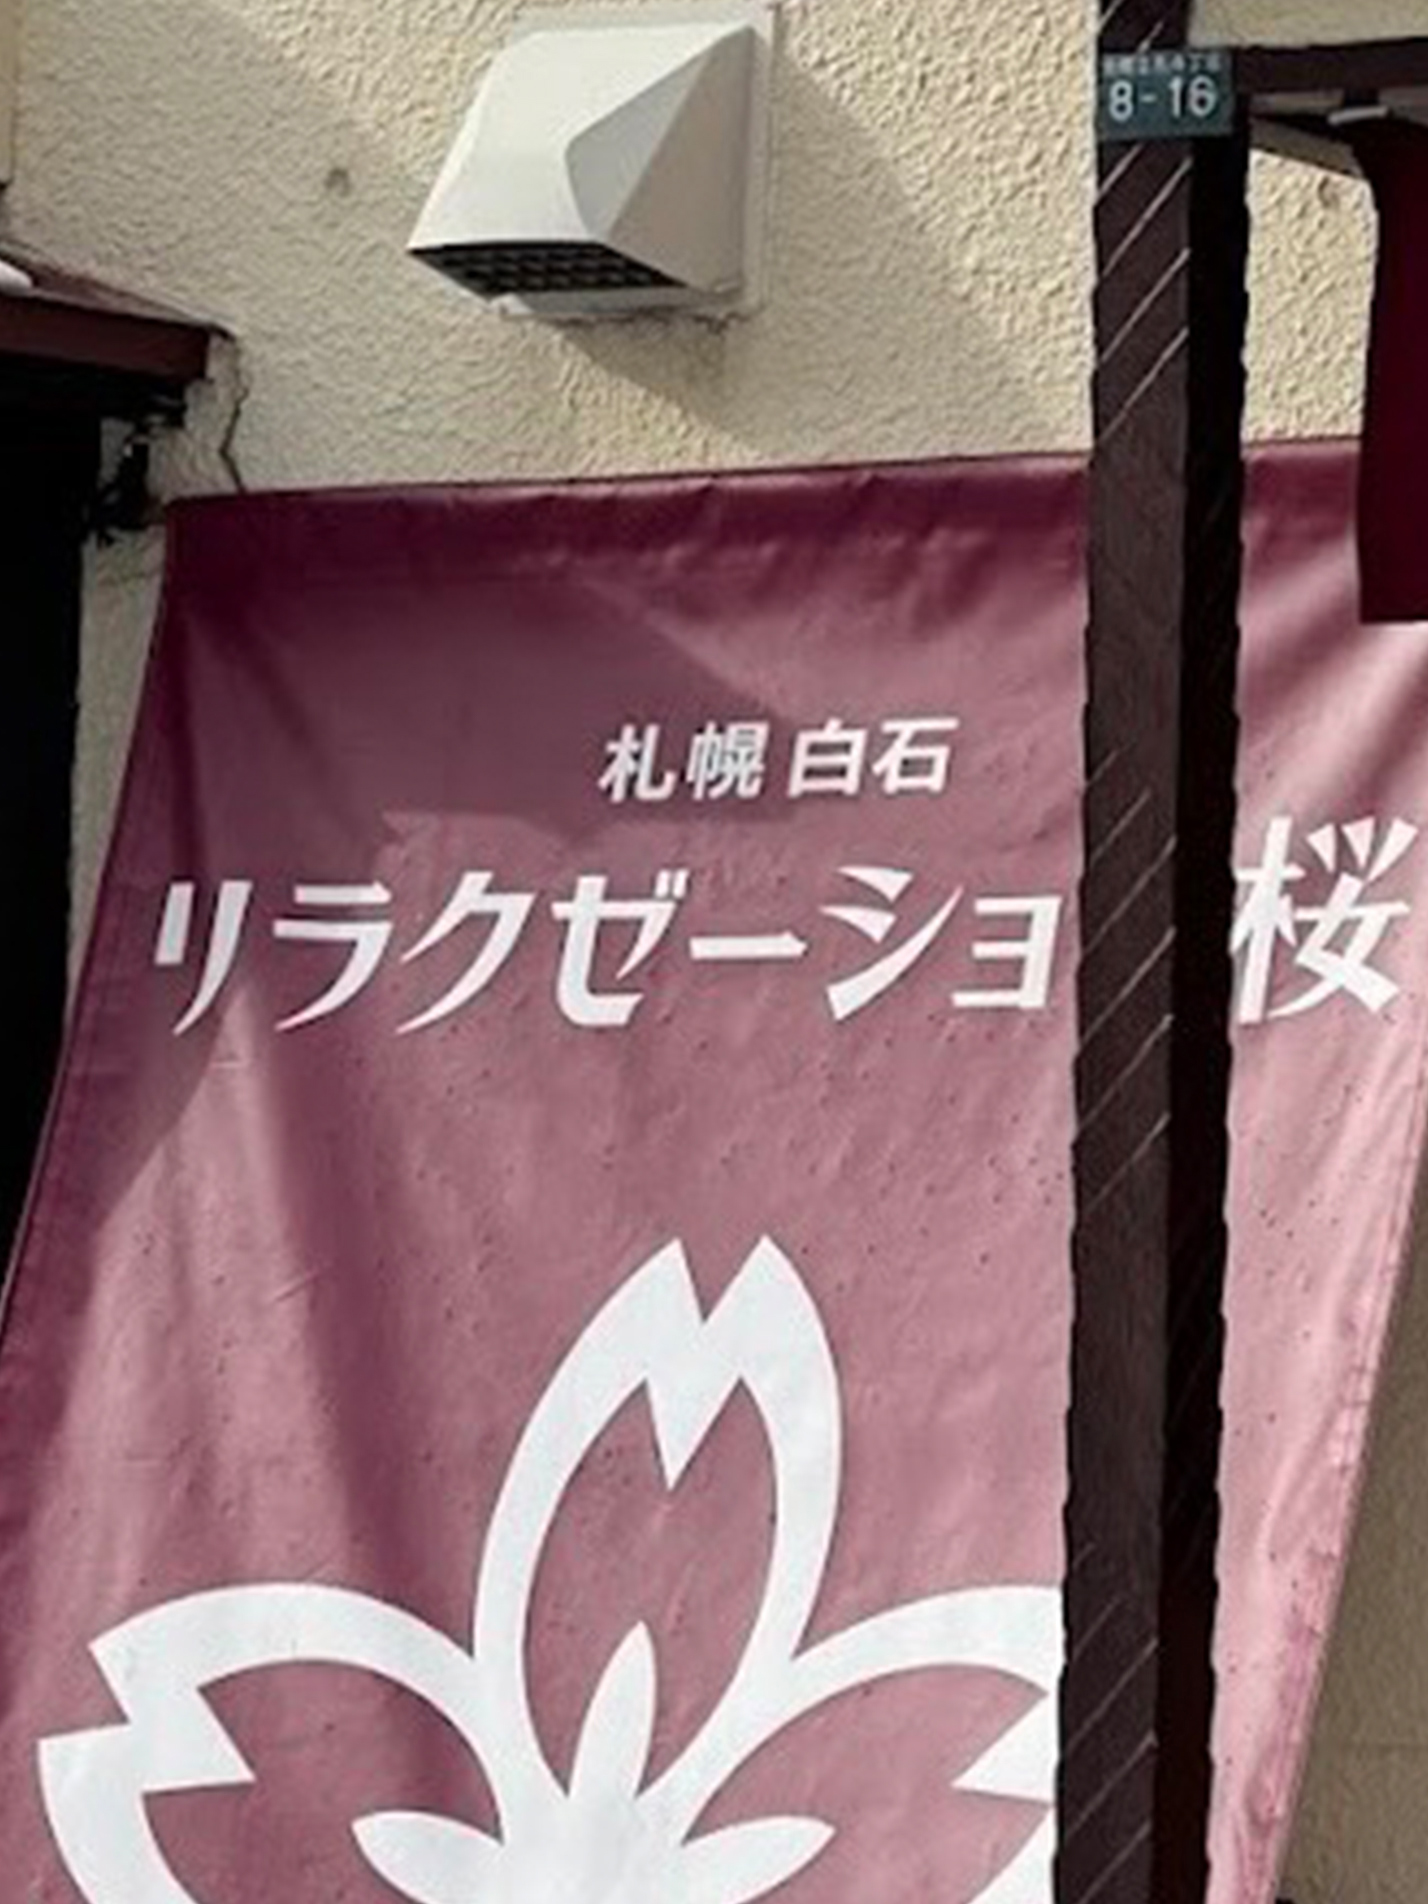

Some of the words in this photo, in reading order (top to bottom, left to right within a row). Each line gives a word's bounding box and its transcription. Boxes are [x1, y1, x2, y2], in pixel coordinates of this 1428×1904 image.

[1109, 76, 1215, 121] 8-16
[153, 813, 1420, 1035] リラクゼーショ桜
